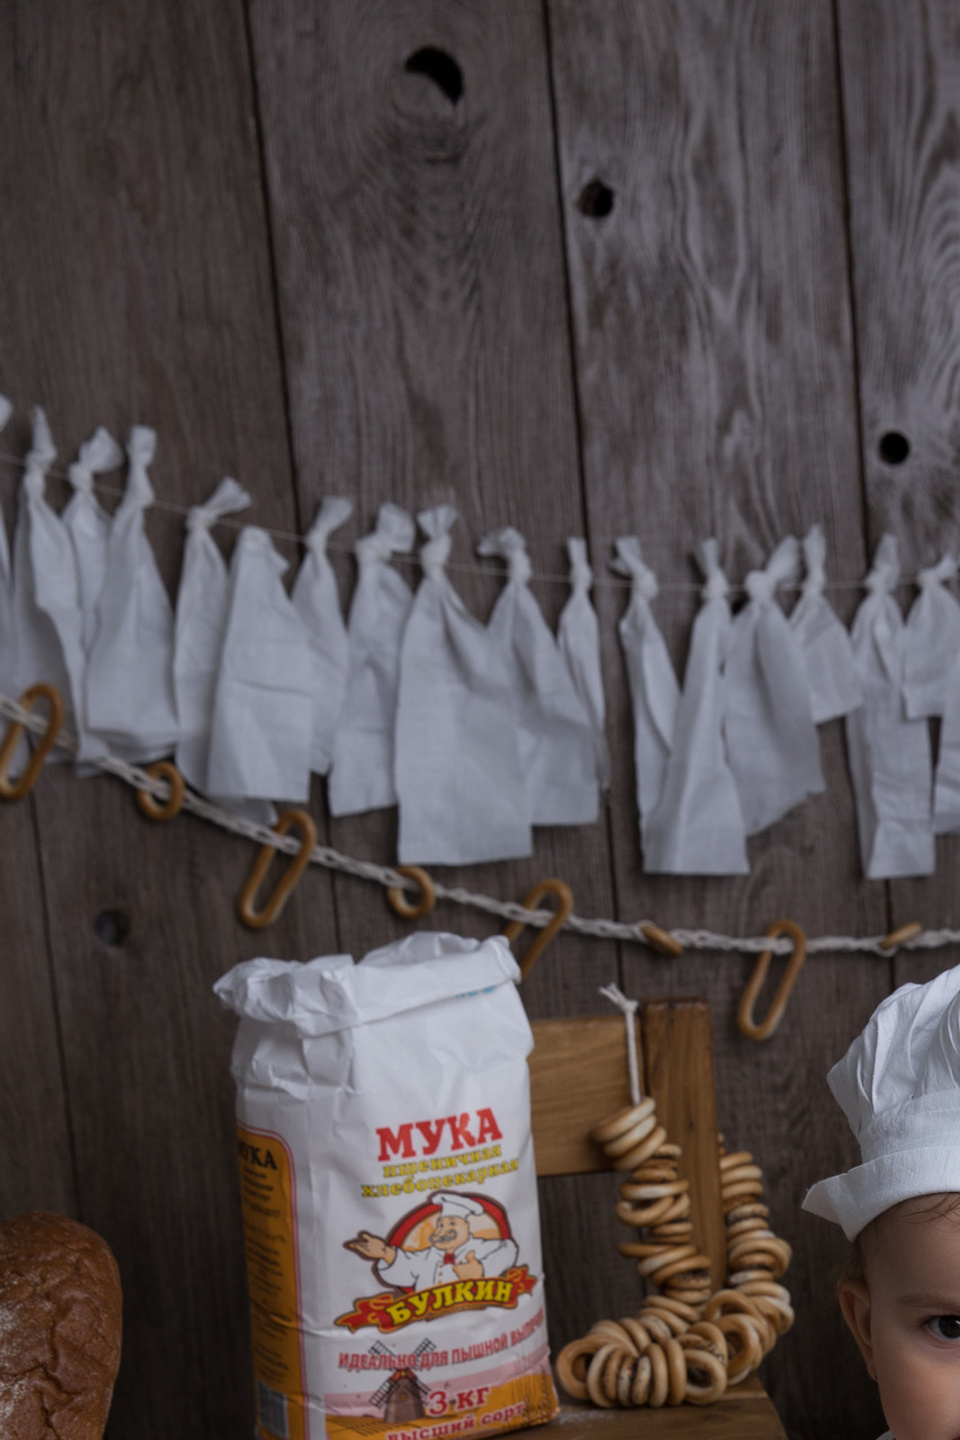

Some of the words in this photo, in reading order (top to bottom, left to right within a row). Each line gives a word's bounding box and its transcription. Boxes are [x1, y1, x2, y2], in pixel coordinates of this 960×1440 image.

[376, 1107, 503, 1162] МУКА
[361, 1158, 519, 1197] хлебопекарная
[382, 1144, 502, 1178] пшеничная
[384, 1280, 514, 1326] БУЛКИН
[338, 1352, 417, 1372] ИДЕАЛЬНО
[419, 1350, 448, 1371] ДЛЯ
[451, 1336, 509, 1365] ПЫШНОЙ
[429, 1391, 448, 1415] 3
[481, 1402, 526, 1425] сорт
